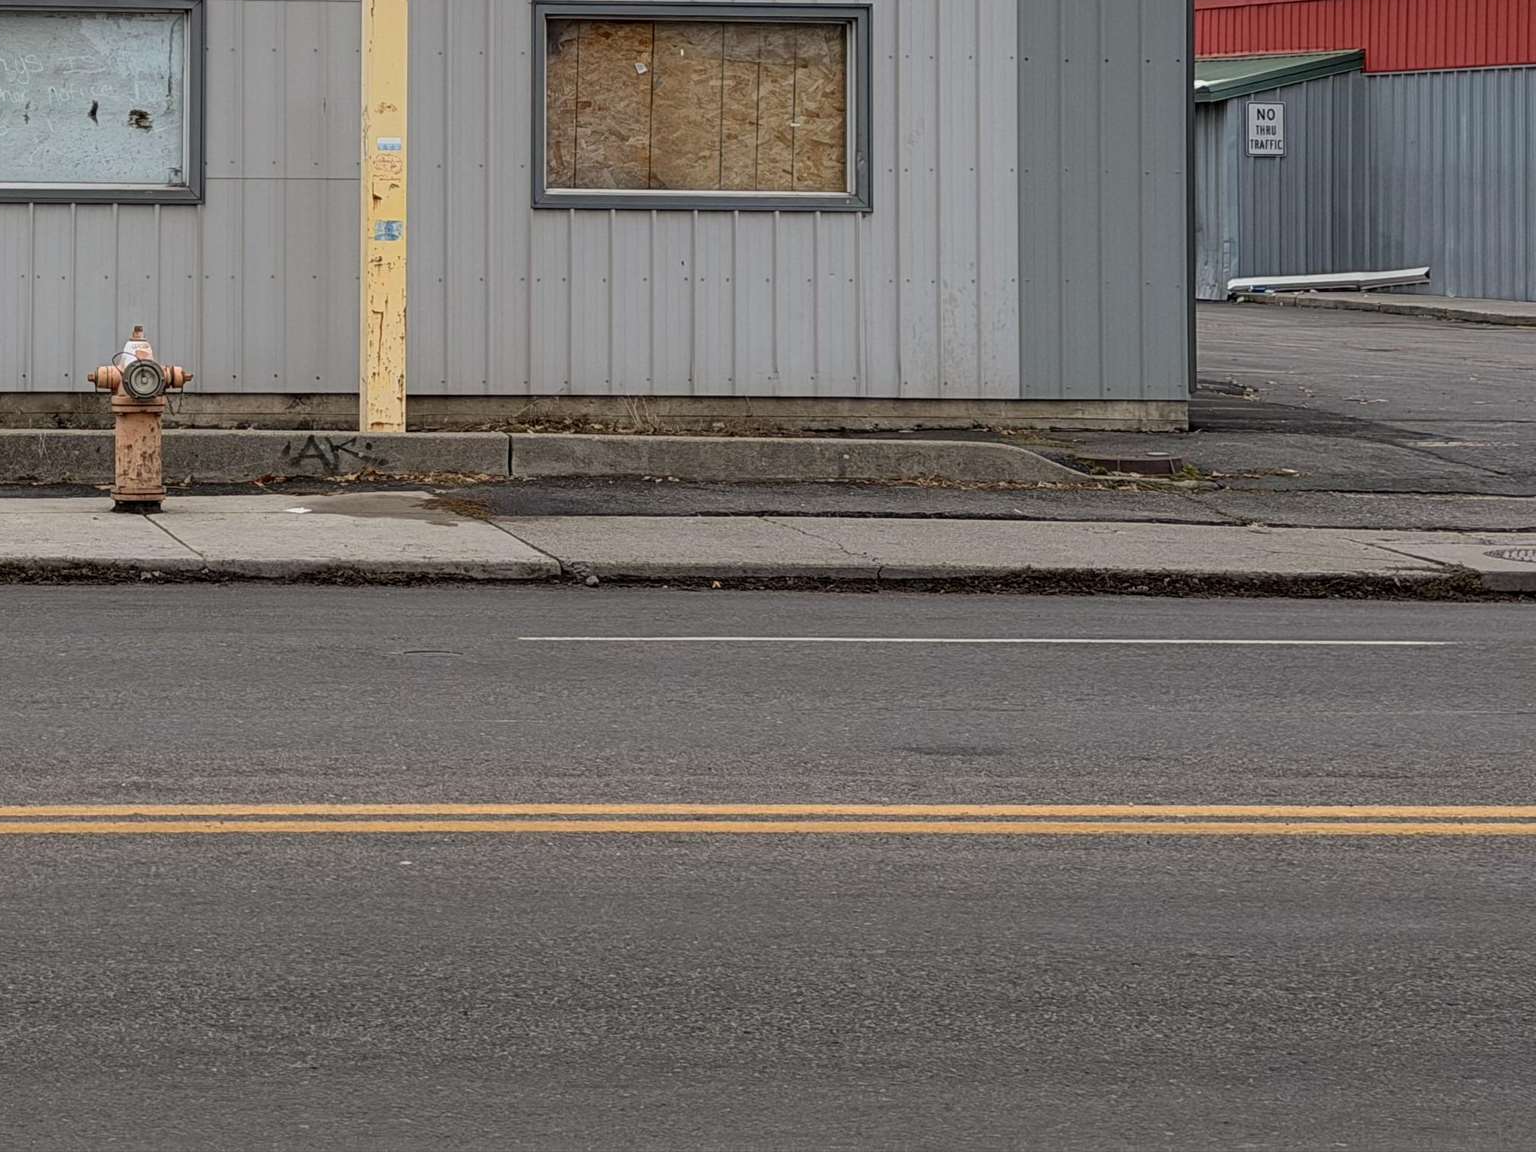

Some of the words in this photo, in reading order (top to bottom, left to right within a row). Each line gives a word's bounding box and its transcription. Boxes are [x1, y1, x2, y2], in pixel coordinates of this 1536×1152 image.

[1256, 108, 1276, 121] NO
[1255, 124, 1277, 136] THRU
[1250, 138, 1283, 150] TRAFFIC
